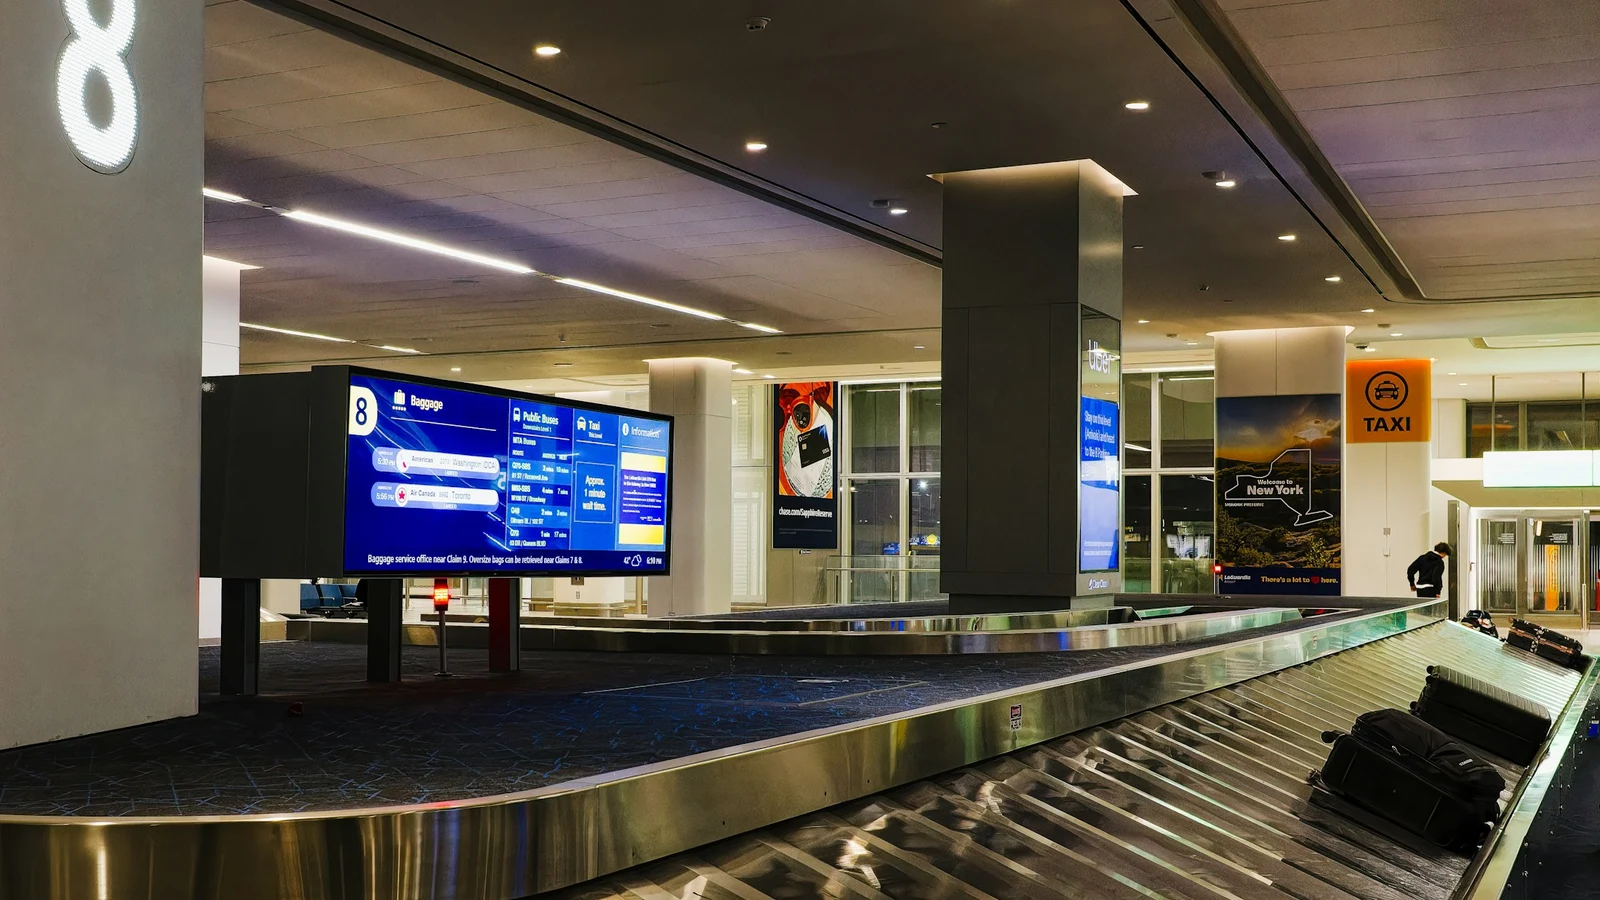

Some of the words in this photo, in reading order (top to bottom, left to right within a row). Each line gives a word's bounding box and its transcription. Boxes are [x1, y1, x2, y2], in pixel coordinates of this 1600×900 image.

[57, 0, 137, 168] 8
[1088, 340, 1112, 374] Uber
[411, 394, 443, 411] Baggage
[356, 397, 367, 426] 8
[523, 411, 541, 422] Public
[542, 414, 559, 425] Buses
[588, 420, 600, 430] Taxi
[1364, 417, 1411, 432] TAXI
[632, 426, 660, 438] Information
[452, 458, 481, 469] Washington
[585, 475, 605, 487] Approx.
[452, 491, 471, 500] Toronto
[584, 488, 588, 497] 1
[588, 489, 606, 498] minute
[1247, 485, 1274, 495] New
[1275, 485, 1304, 495] York
[582, 501, 593, 510] wait
[594, 501, 606, 510] time.
[778, 506, 832, 518] chase.com/SapphireReserve
[368, 554, 394, 565] Baggage
[395, 554, 415, 563] service
[416, 554, 432, 563] office
[447, 555, 462, 563] Claim
[463, 555, 468, 564] 9.
[469, 555, 491, 564] Oversize
[492, 555, 504, 565] bags
[515, 555, 521, 564] be
[522, 555, 543, 564] retrieved
